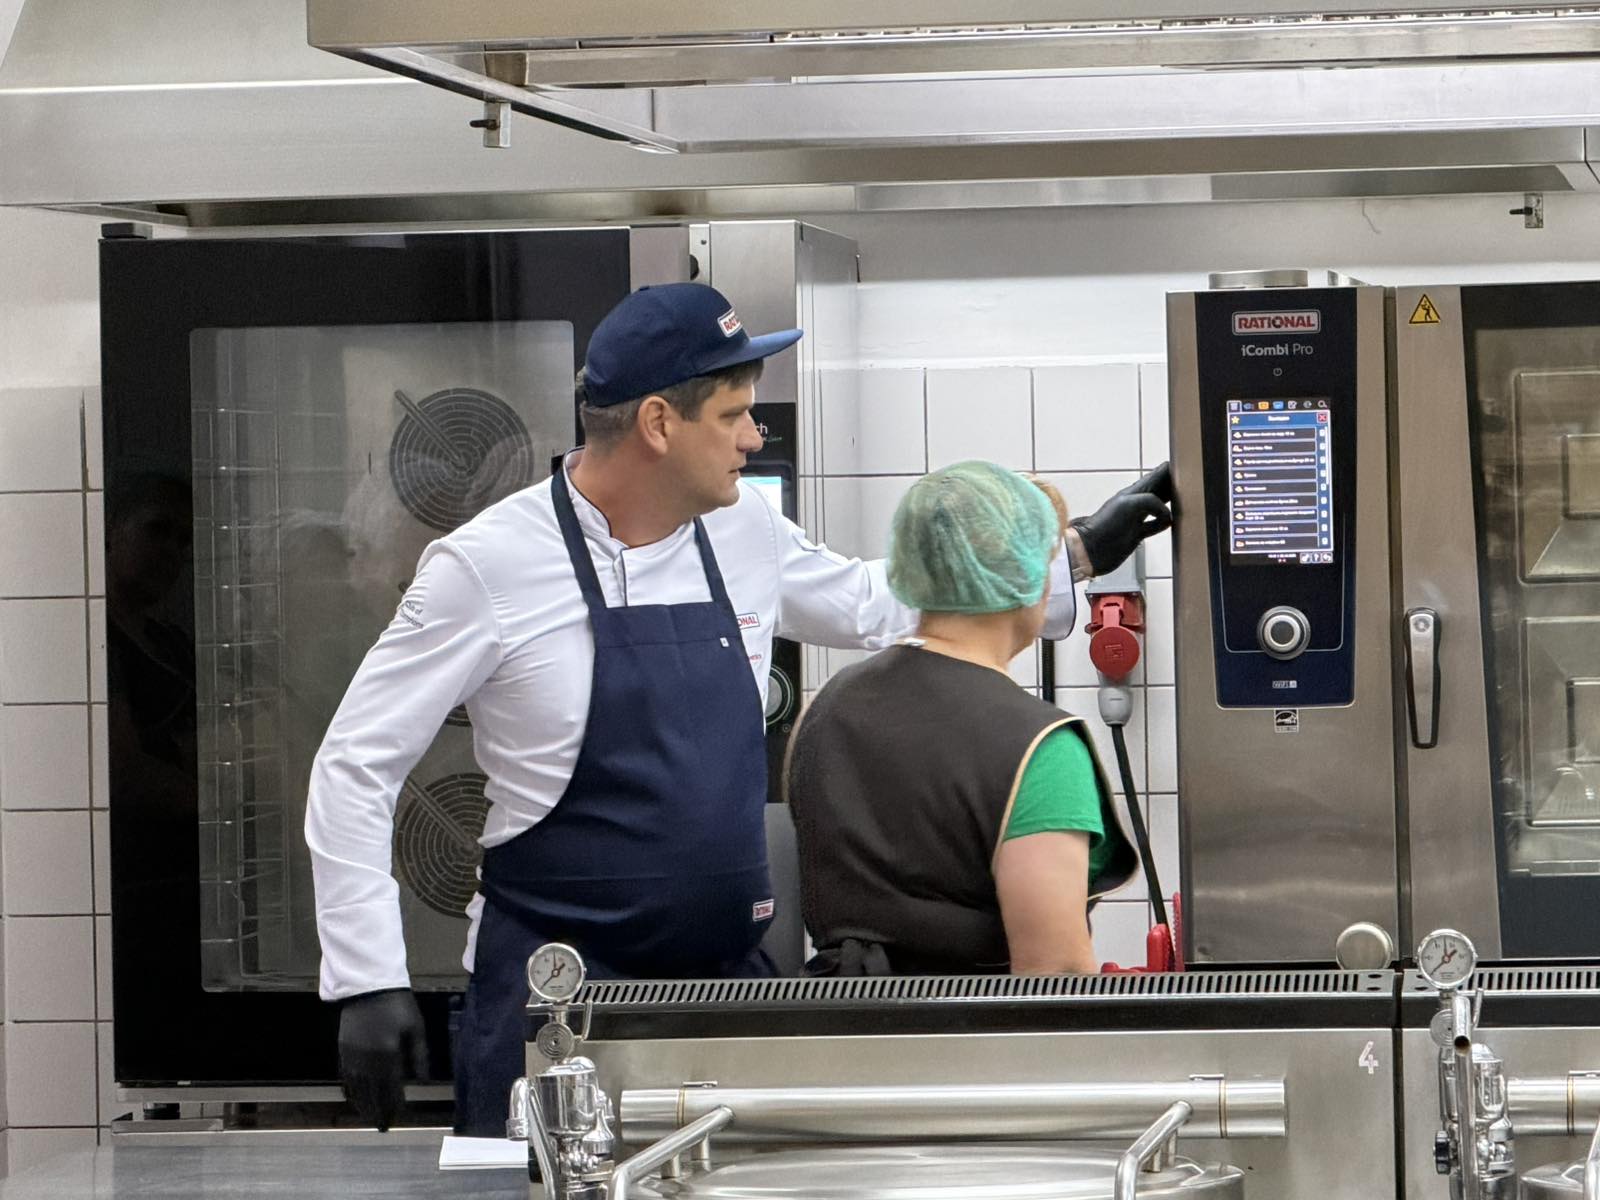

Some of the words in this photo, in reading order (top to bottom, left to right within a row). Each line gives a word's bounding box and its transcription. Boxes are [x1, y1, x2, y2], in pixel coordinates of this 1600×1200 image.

[1237, 315, 1316, 330] RATIONAL
[1241, 343, 1289, 357] iCombi
[1292, 343, 1314, 355] Pro
[1358, 1040, 1380, 1075] 4
